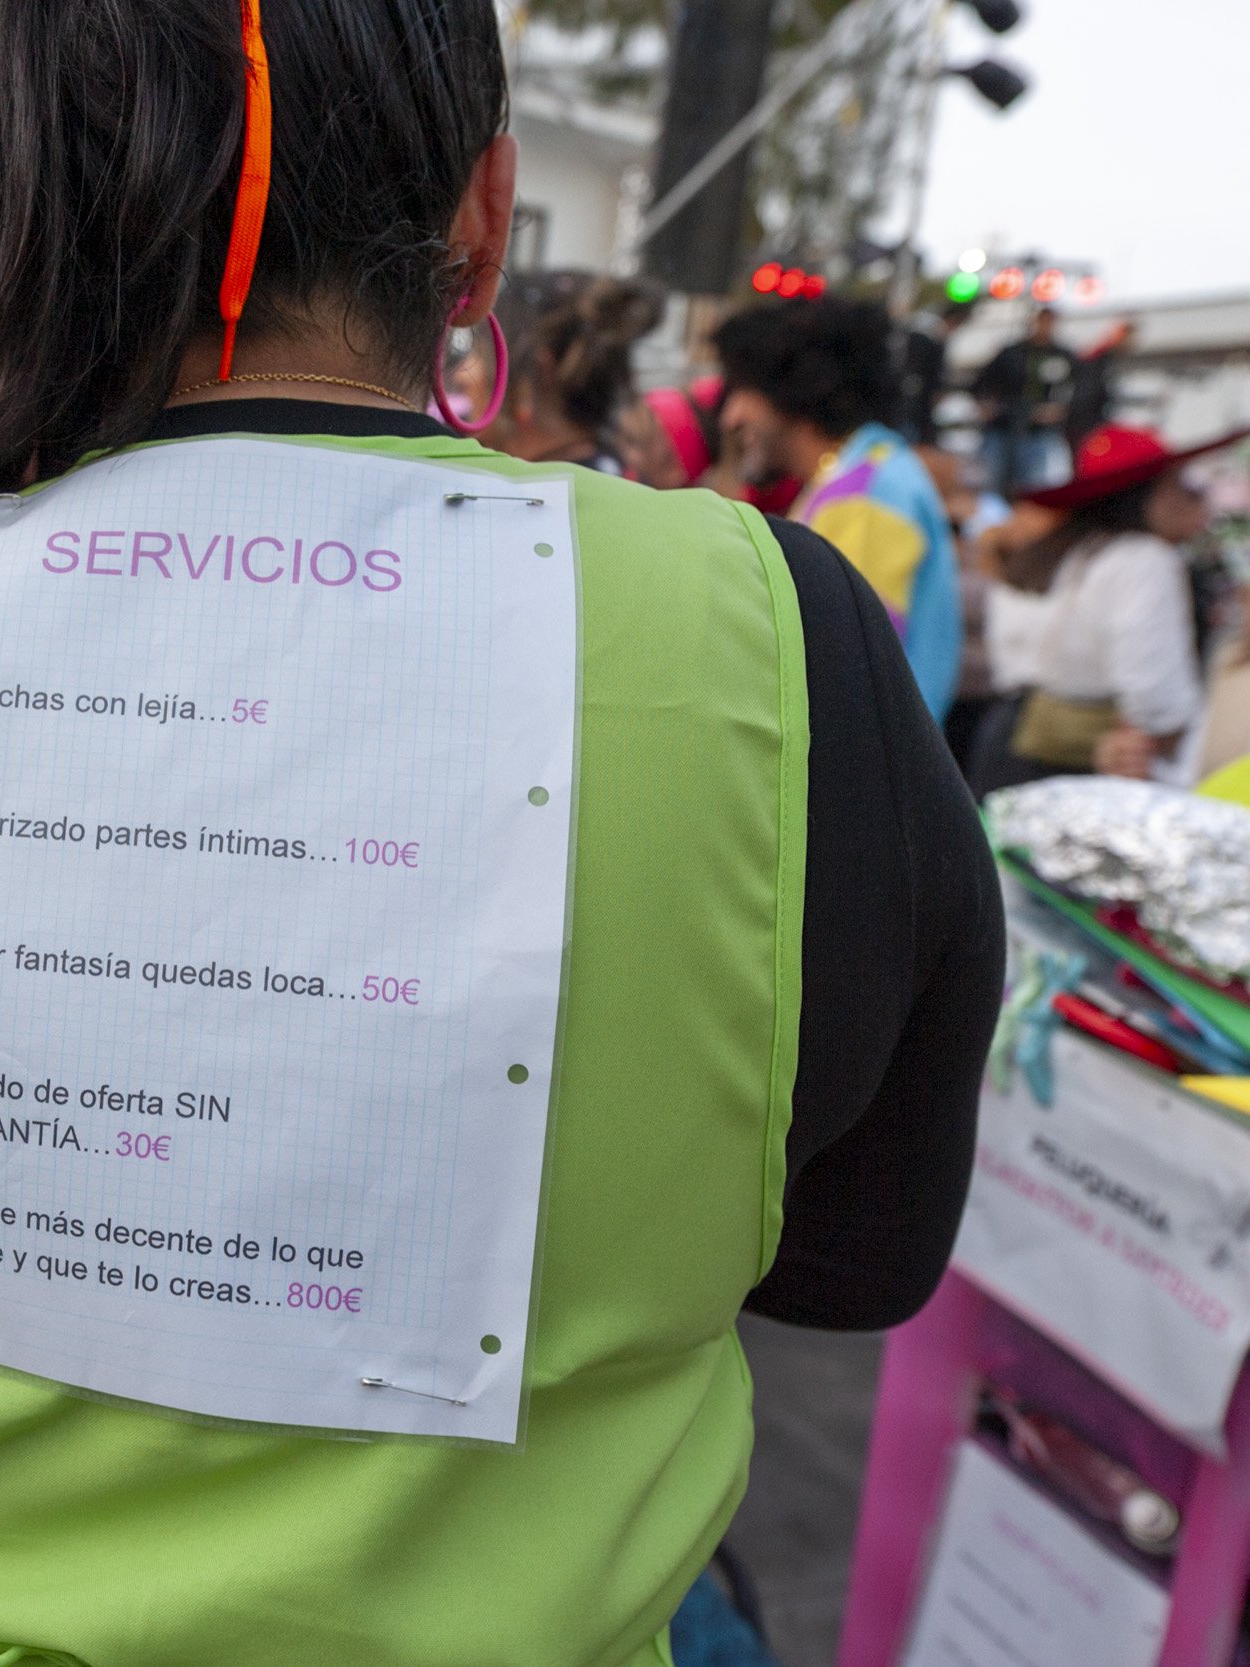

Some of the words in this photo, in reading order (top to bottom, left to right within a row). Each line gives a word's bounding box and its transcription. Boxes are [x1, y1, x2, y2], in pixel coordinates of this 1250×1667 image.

[41, 530, 403, 593] SERVICIOS
[74, 694, 127, 716] con
[95, 822, 188, 851] partes
[14, 943, 131, 980] fantasía
[141, 960, 252, 991] quedas
[33, 1078, 70, 1106] de
[79, 1083, 164, 1117] oferta
[174, 1091, 231, 1123] SIN
[26, 1210, 85, 1238] más
[94, 1217, 213, 1256] decente
[223, 1232, 261, 1261] de
[271, 1235, 297, 1264] lo
[306, 1246, 364, 1273] que
[12, 1249, 28, 1274] y
[36, 1254, 89, 1281] que
[97, 1260, 124, 1287] te
[134, 1264, 159, 1293] lo
